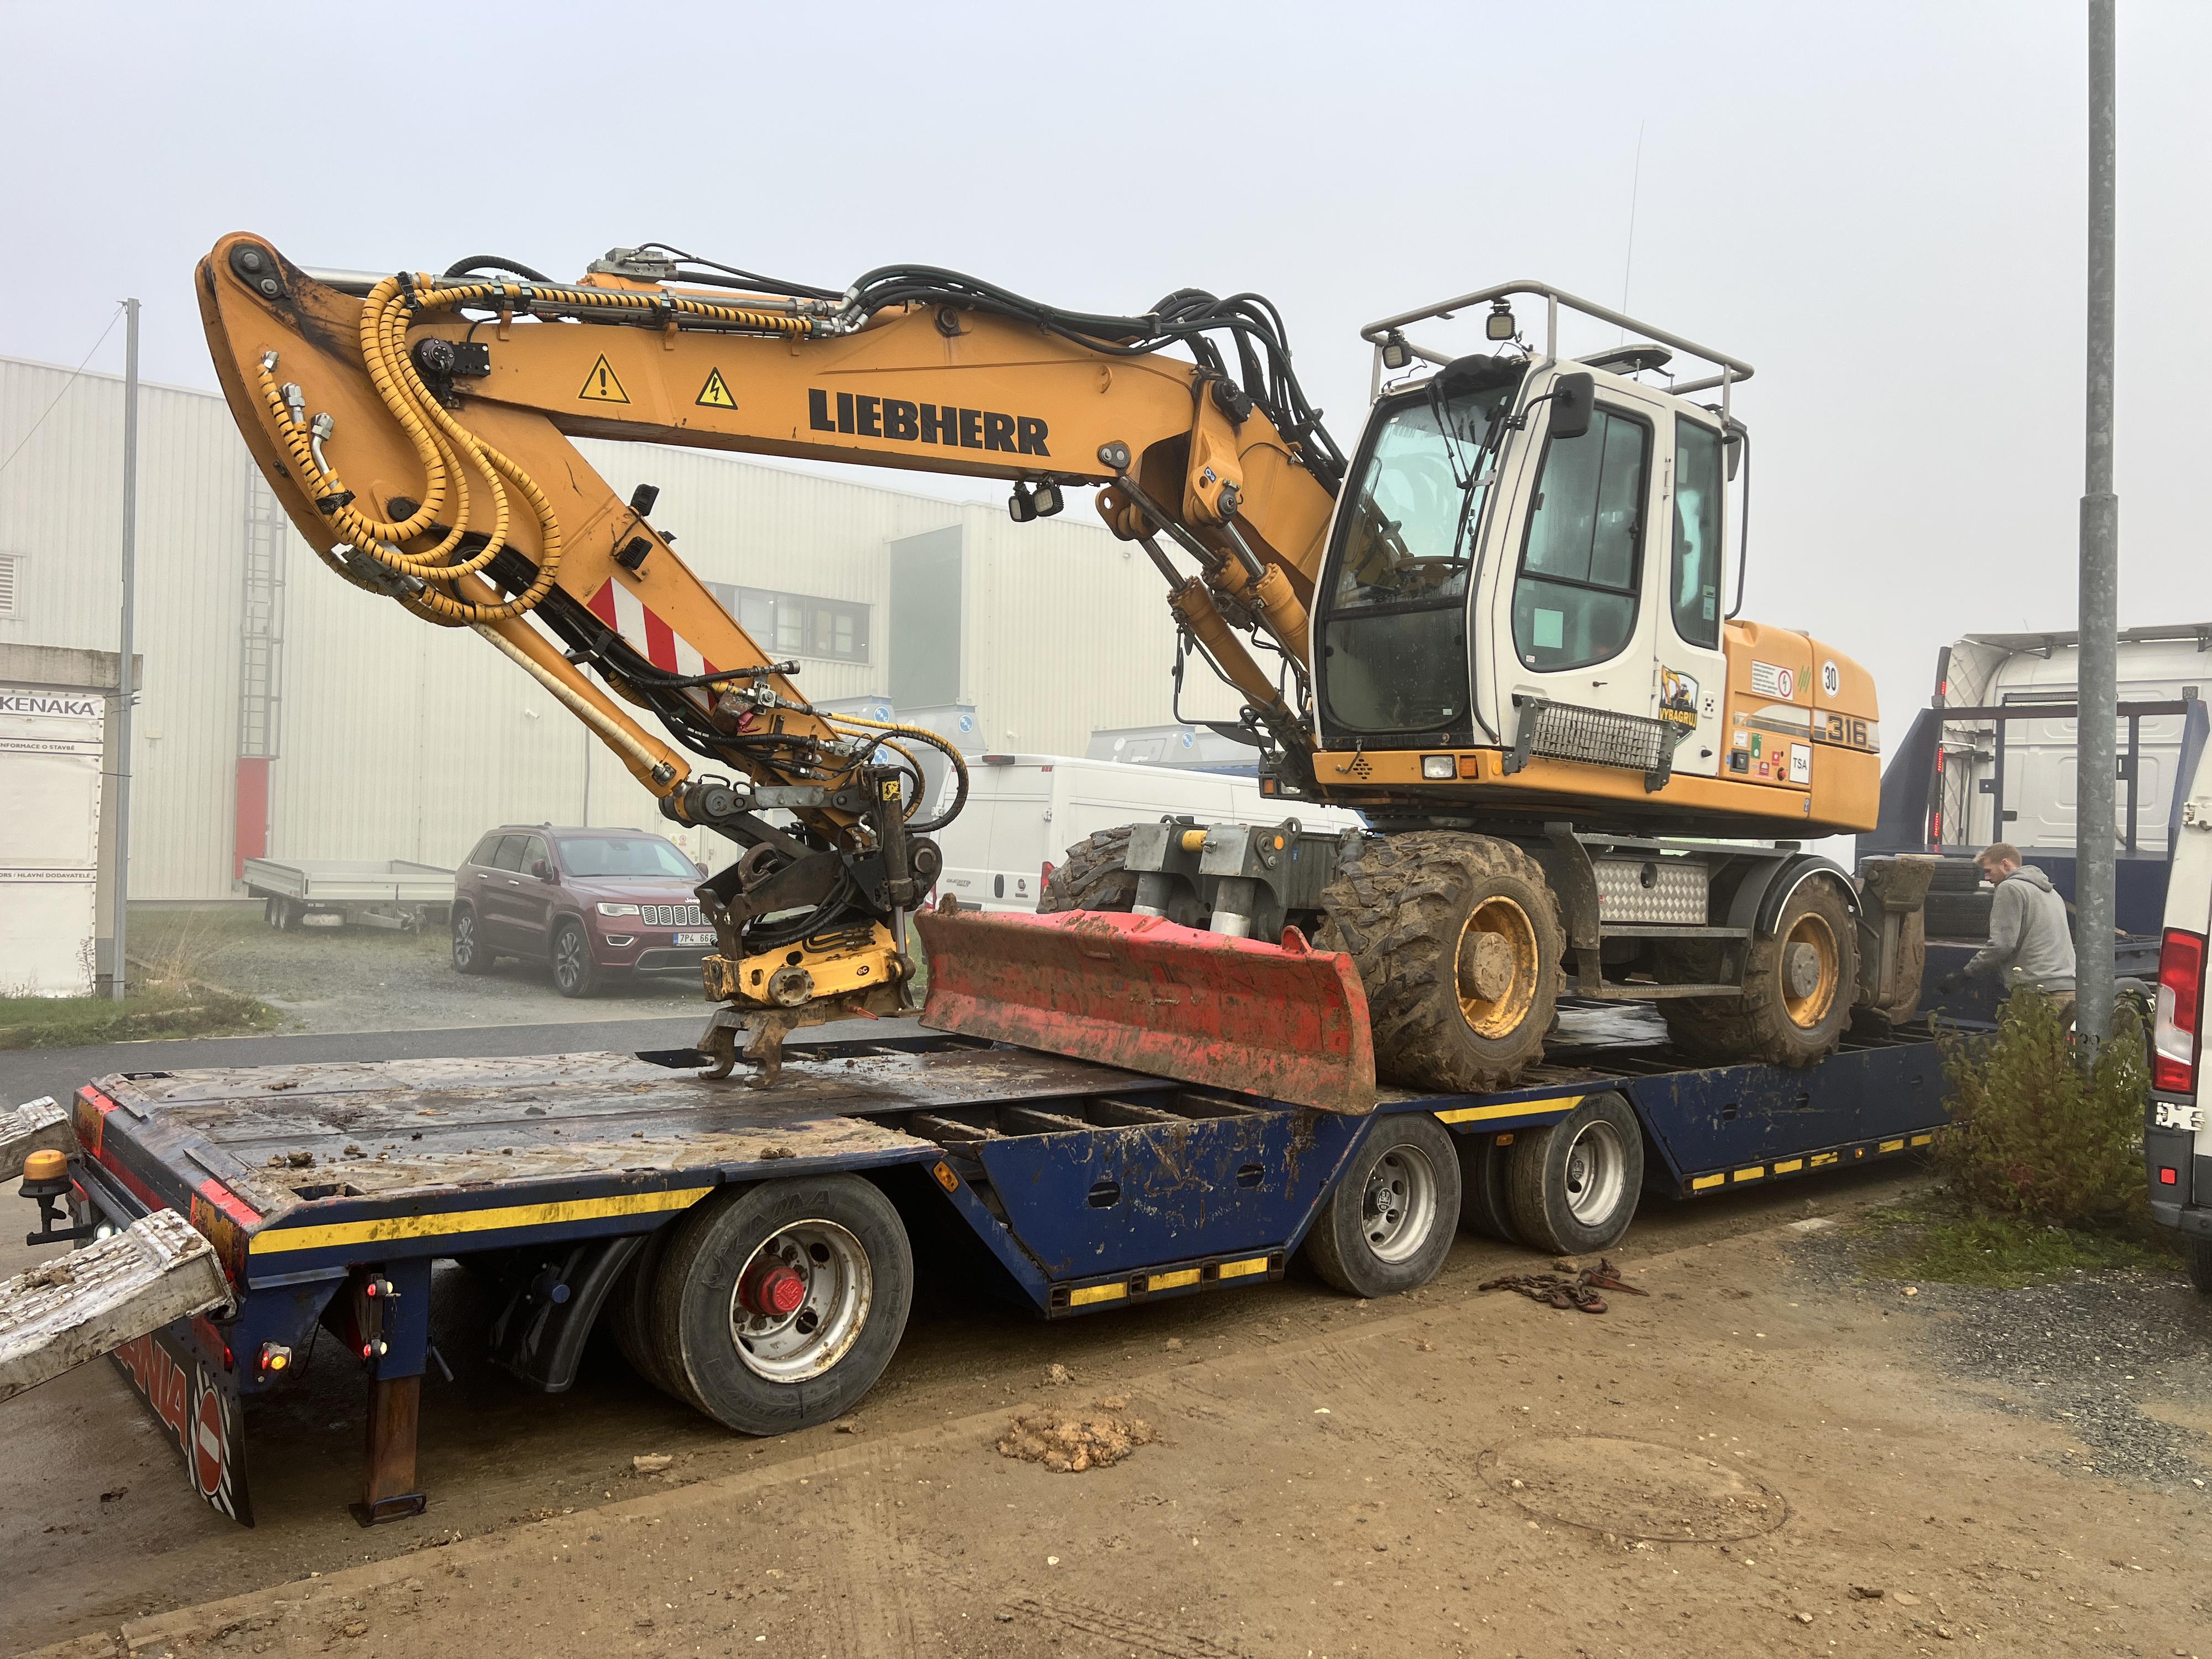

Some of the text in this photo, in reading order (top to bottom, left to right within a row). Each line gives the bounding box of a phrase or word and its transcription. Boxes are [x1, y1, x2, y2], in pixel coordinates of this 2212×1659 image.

[808, 388, 1051, 457] LIEBHERR
[1825, 666, 1836, 691] 30
[1659, 708, 1697, 728] VYBAGRUJ
[1828, 714, 1867, 747] 316
[1793, 758, 1807, 770] TSA
[680, 934, 694, 942] 7P4
[113, 1333, 188, 1457] ANIA
